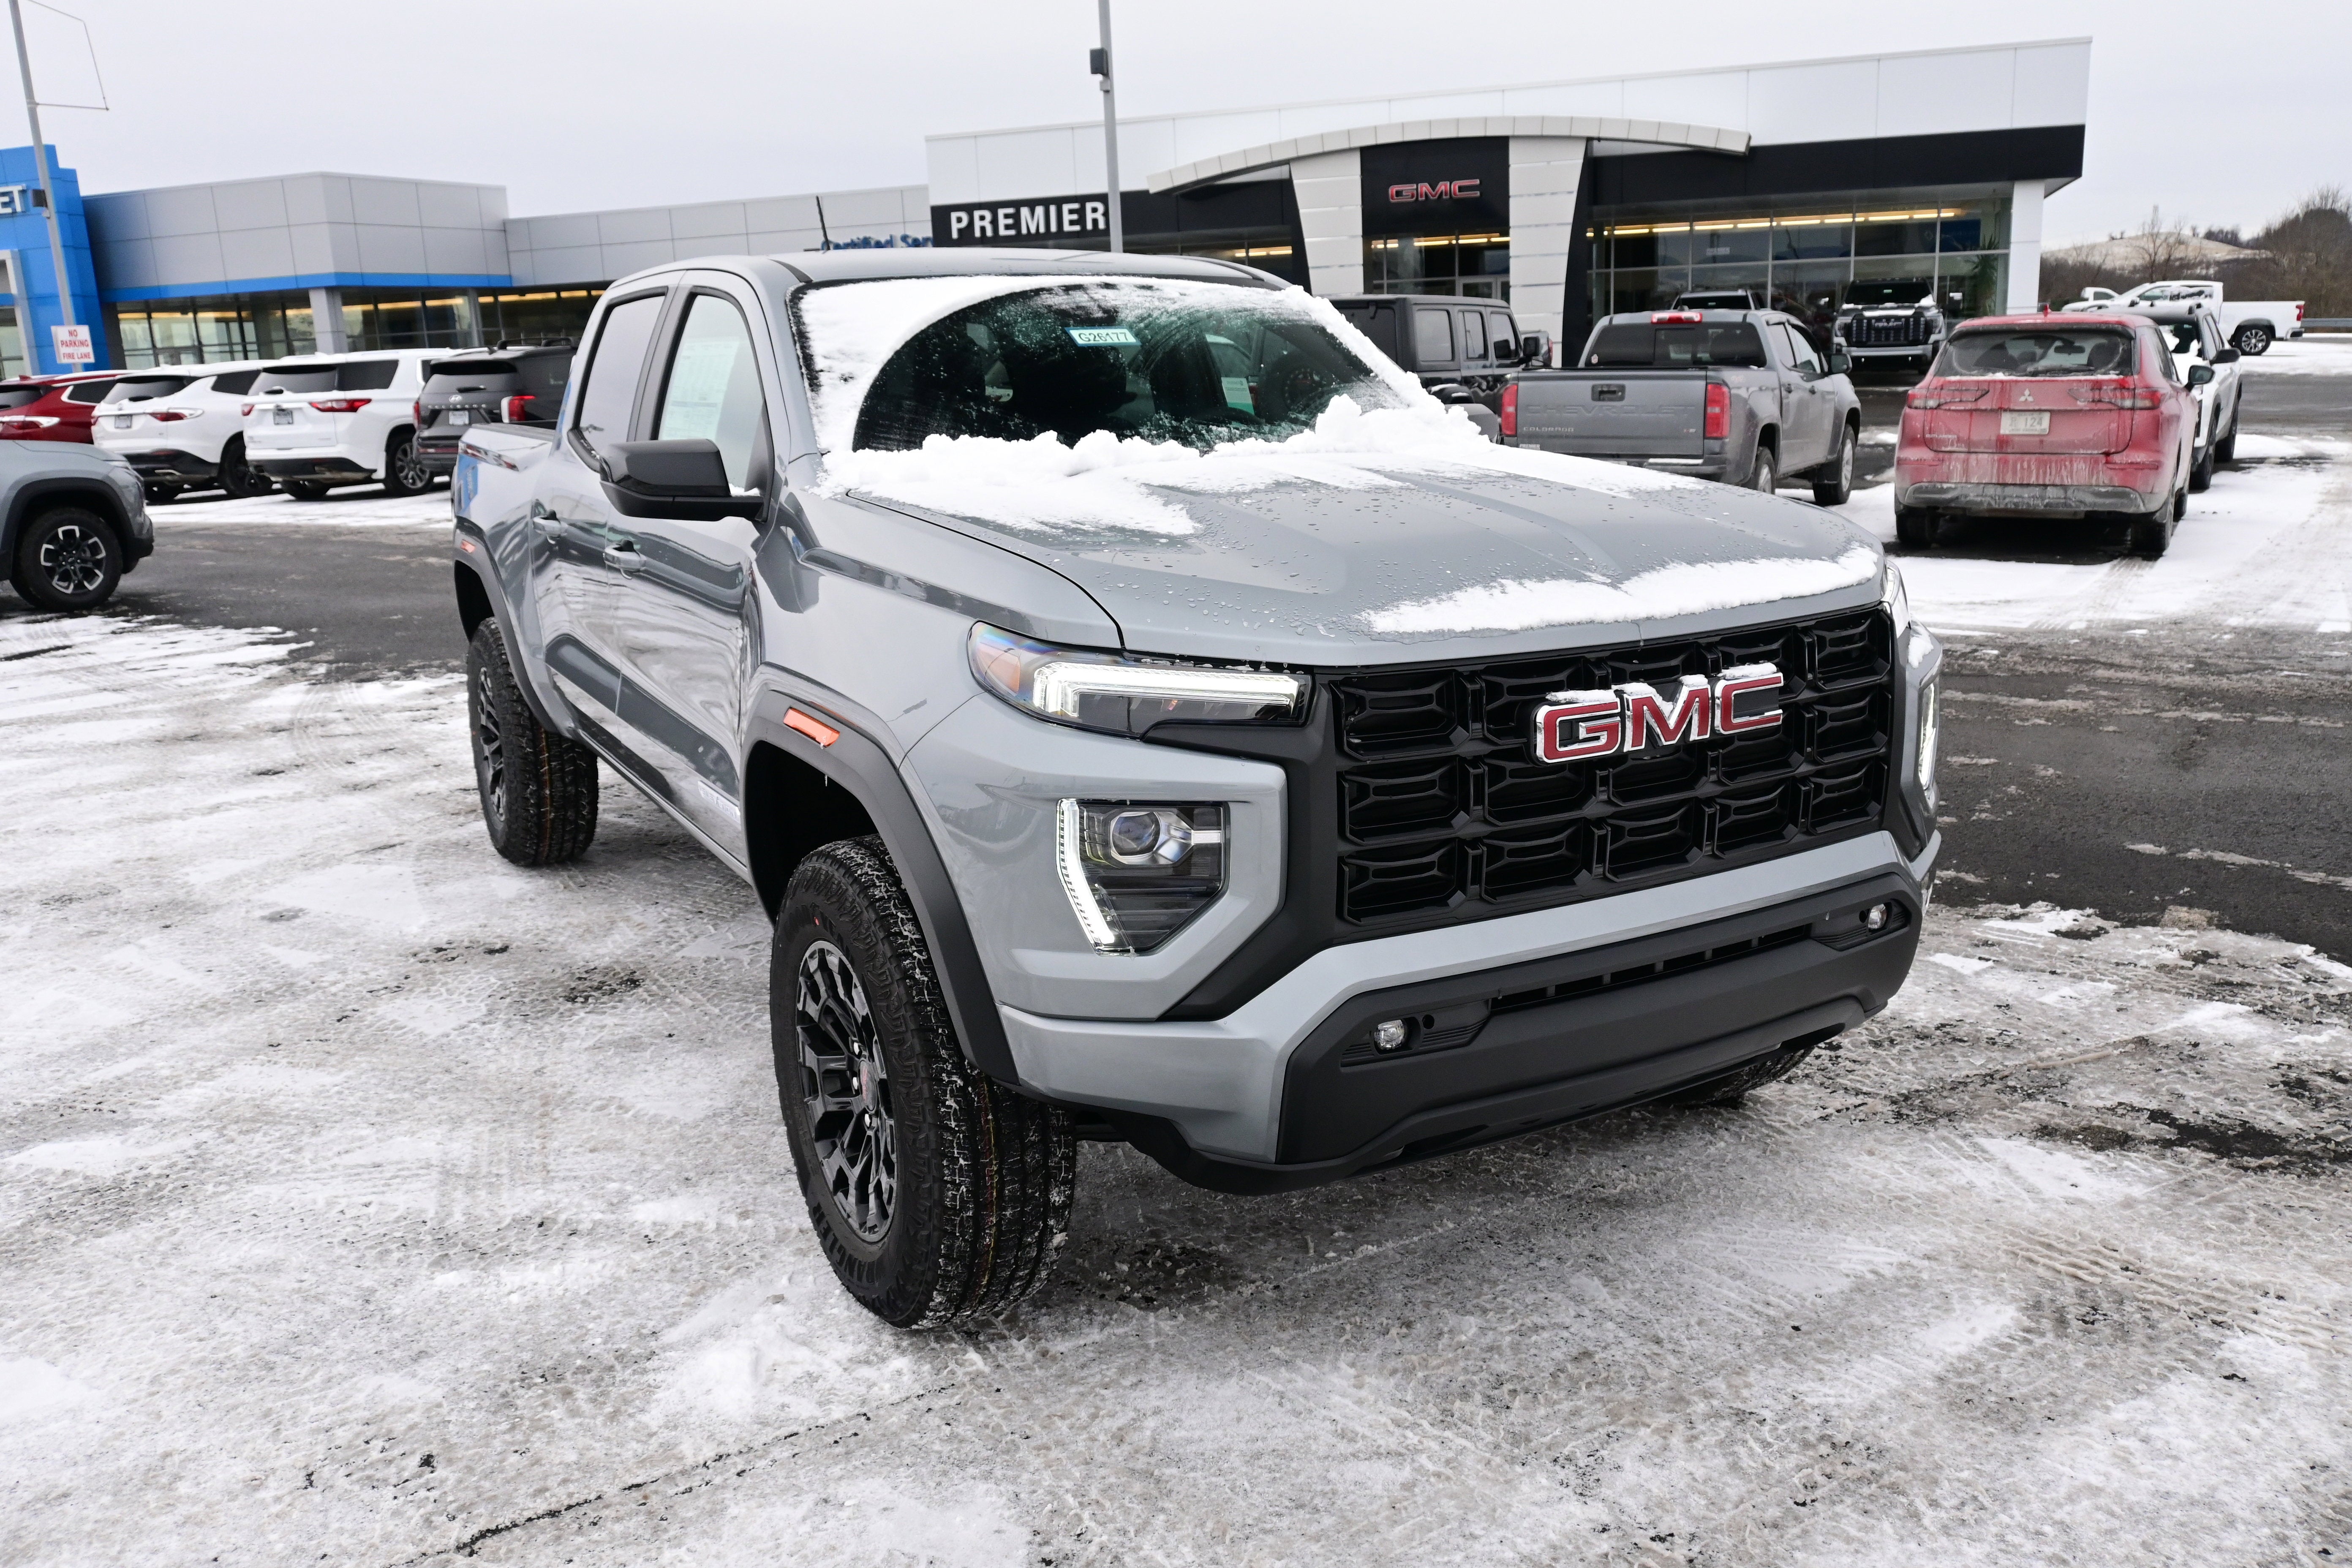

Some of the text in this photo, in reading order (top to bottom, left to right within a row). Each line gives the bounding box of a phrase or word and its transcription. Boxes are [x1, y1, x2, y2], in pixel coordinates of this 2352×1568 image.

[1389, 179, 1480, 203] GMC
[950, 201, 1107, 240] PREMIER
[68, 329, 78, 337] NO
[1078, 332, 1128, 342] G26177
[1536, 672, 1783, 763] GMC
